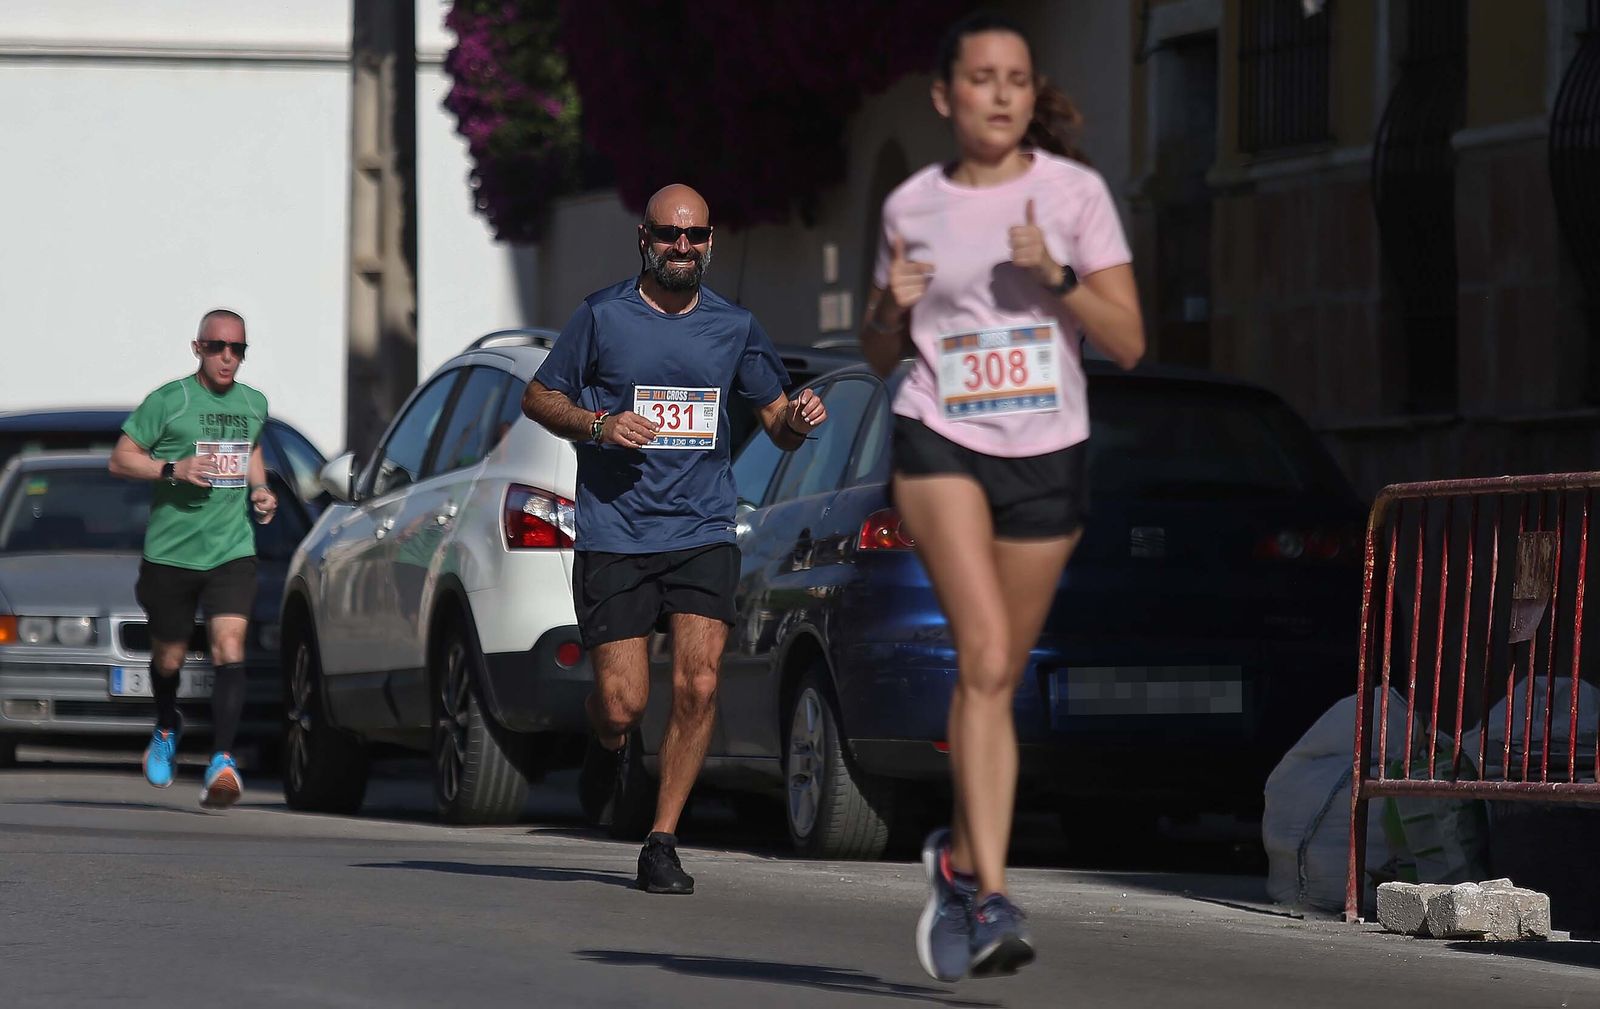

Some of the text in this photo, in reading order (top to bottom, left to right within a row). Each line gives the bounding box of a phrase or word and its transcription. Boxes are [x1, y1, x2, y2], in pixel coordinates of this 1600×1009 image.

[962, 349, 1029, 392] 308
[666, 390, 688, 401] CROSS
[206, 413, 248, 429] CROSS
[652, 403, 694, 430] 331
